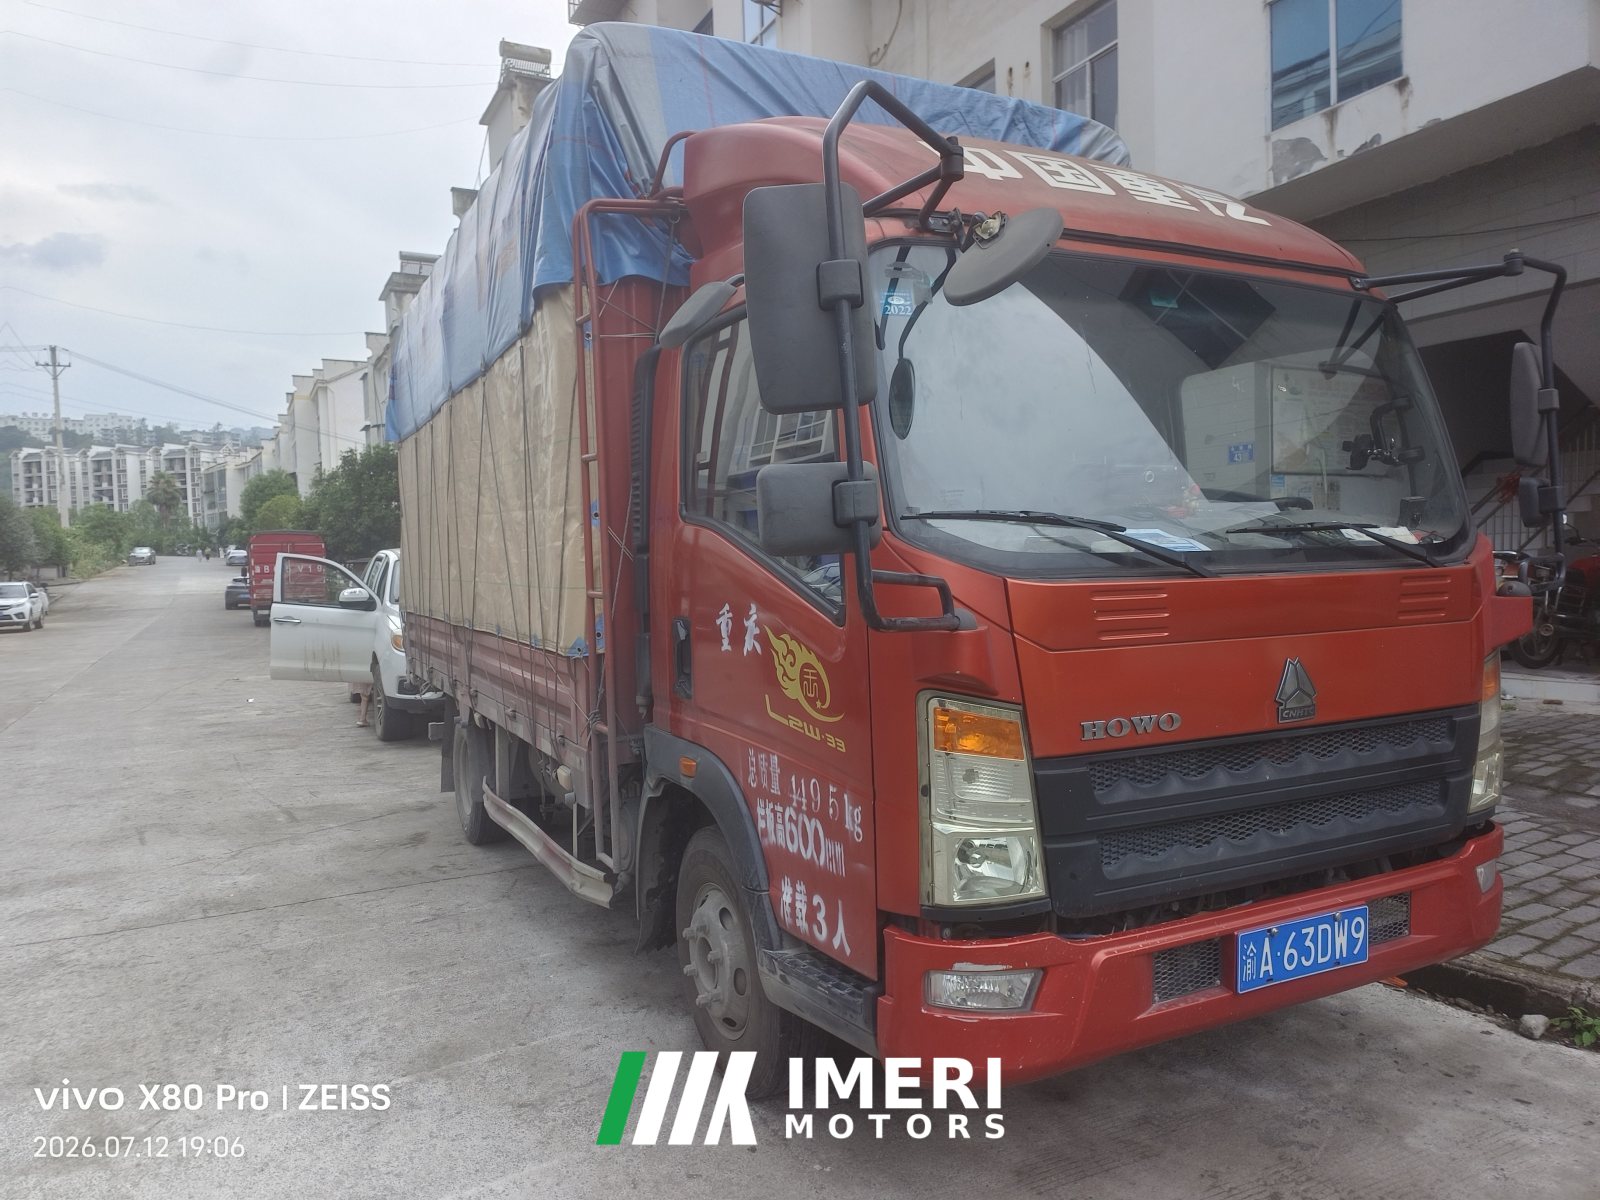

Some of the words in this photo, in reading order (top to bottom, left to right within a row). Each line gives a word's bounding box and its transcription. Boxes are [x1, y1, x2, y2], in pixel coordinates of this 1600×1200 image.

[884, 305, 913, 315] 2022
[716, 603, 761, 656] 重庆
[1081, 713, 1181, 740] HOWO
